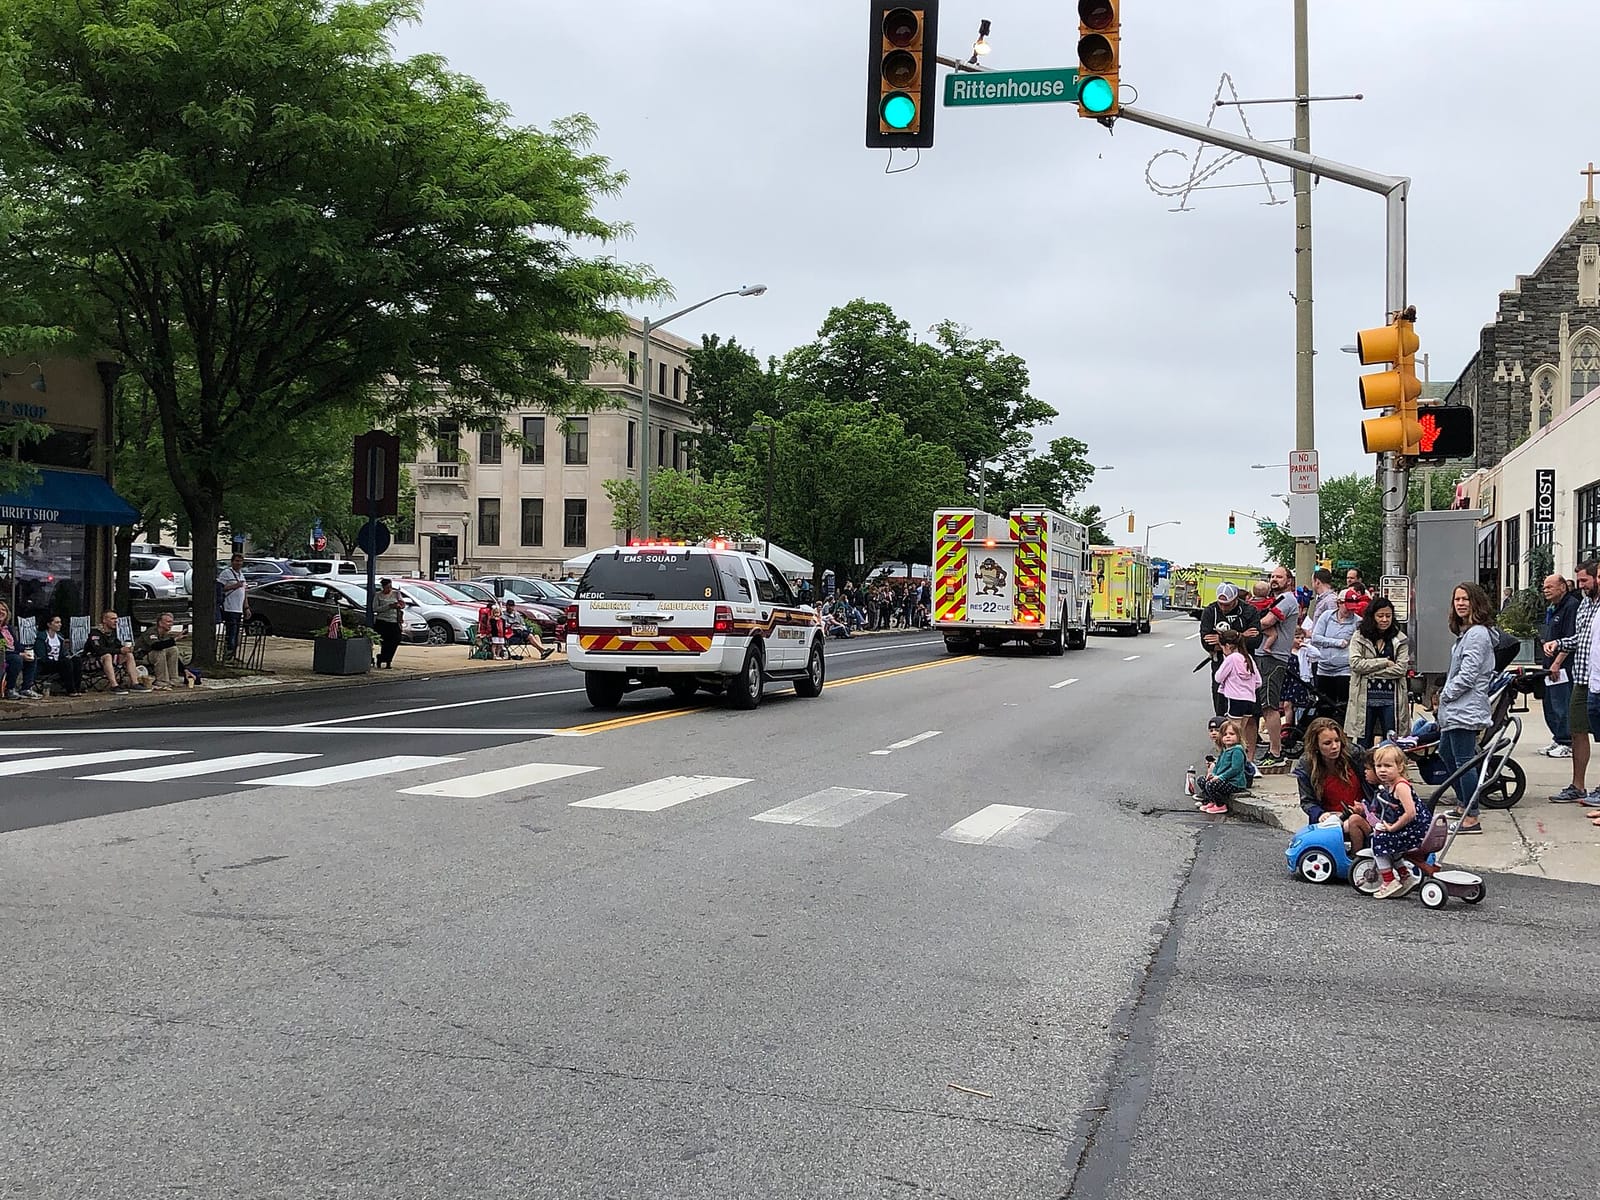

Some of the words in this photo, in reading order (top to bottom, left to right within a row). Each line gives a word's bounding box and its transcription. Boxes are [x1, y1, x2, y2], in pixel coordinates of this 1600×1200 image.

[953, 79, 1064, 100] Rittenhouse
[12, 402, 47, 418] SHOP
[1298, 453, 1309, 462] NO
[1290, 464, 1318, 473] PARKING
[1539, 471, 1552, 520] HOST
[0, 505, 32, 520] HRIFT
[33, 508, 60, 521] SHOP
[623, 555, 642, 563] EMS
[645, 555, 677, 563] SQUAD
[704, 587, 712, 598] 8
